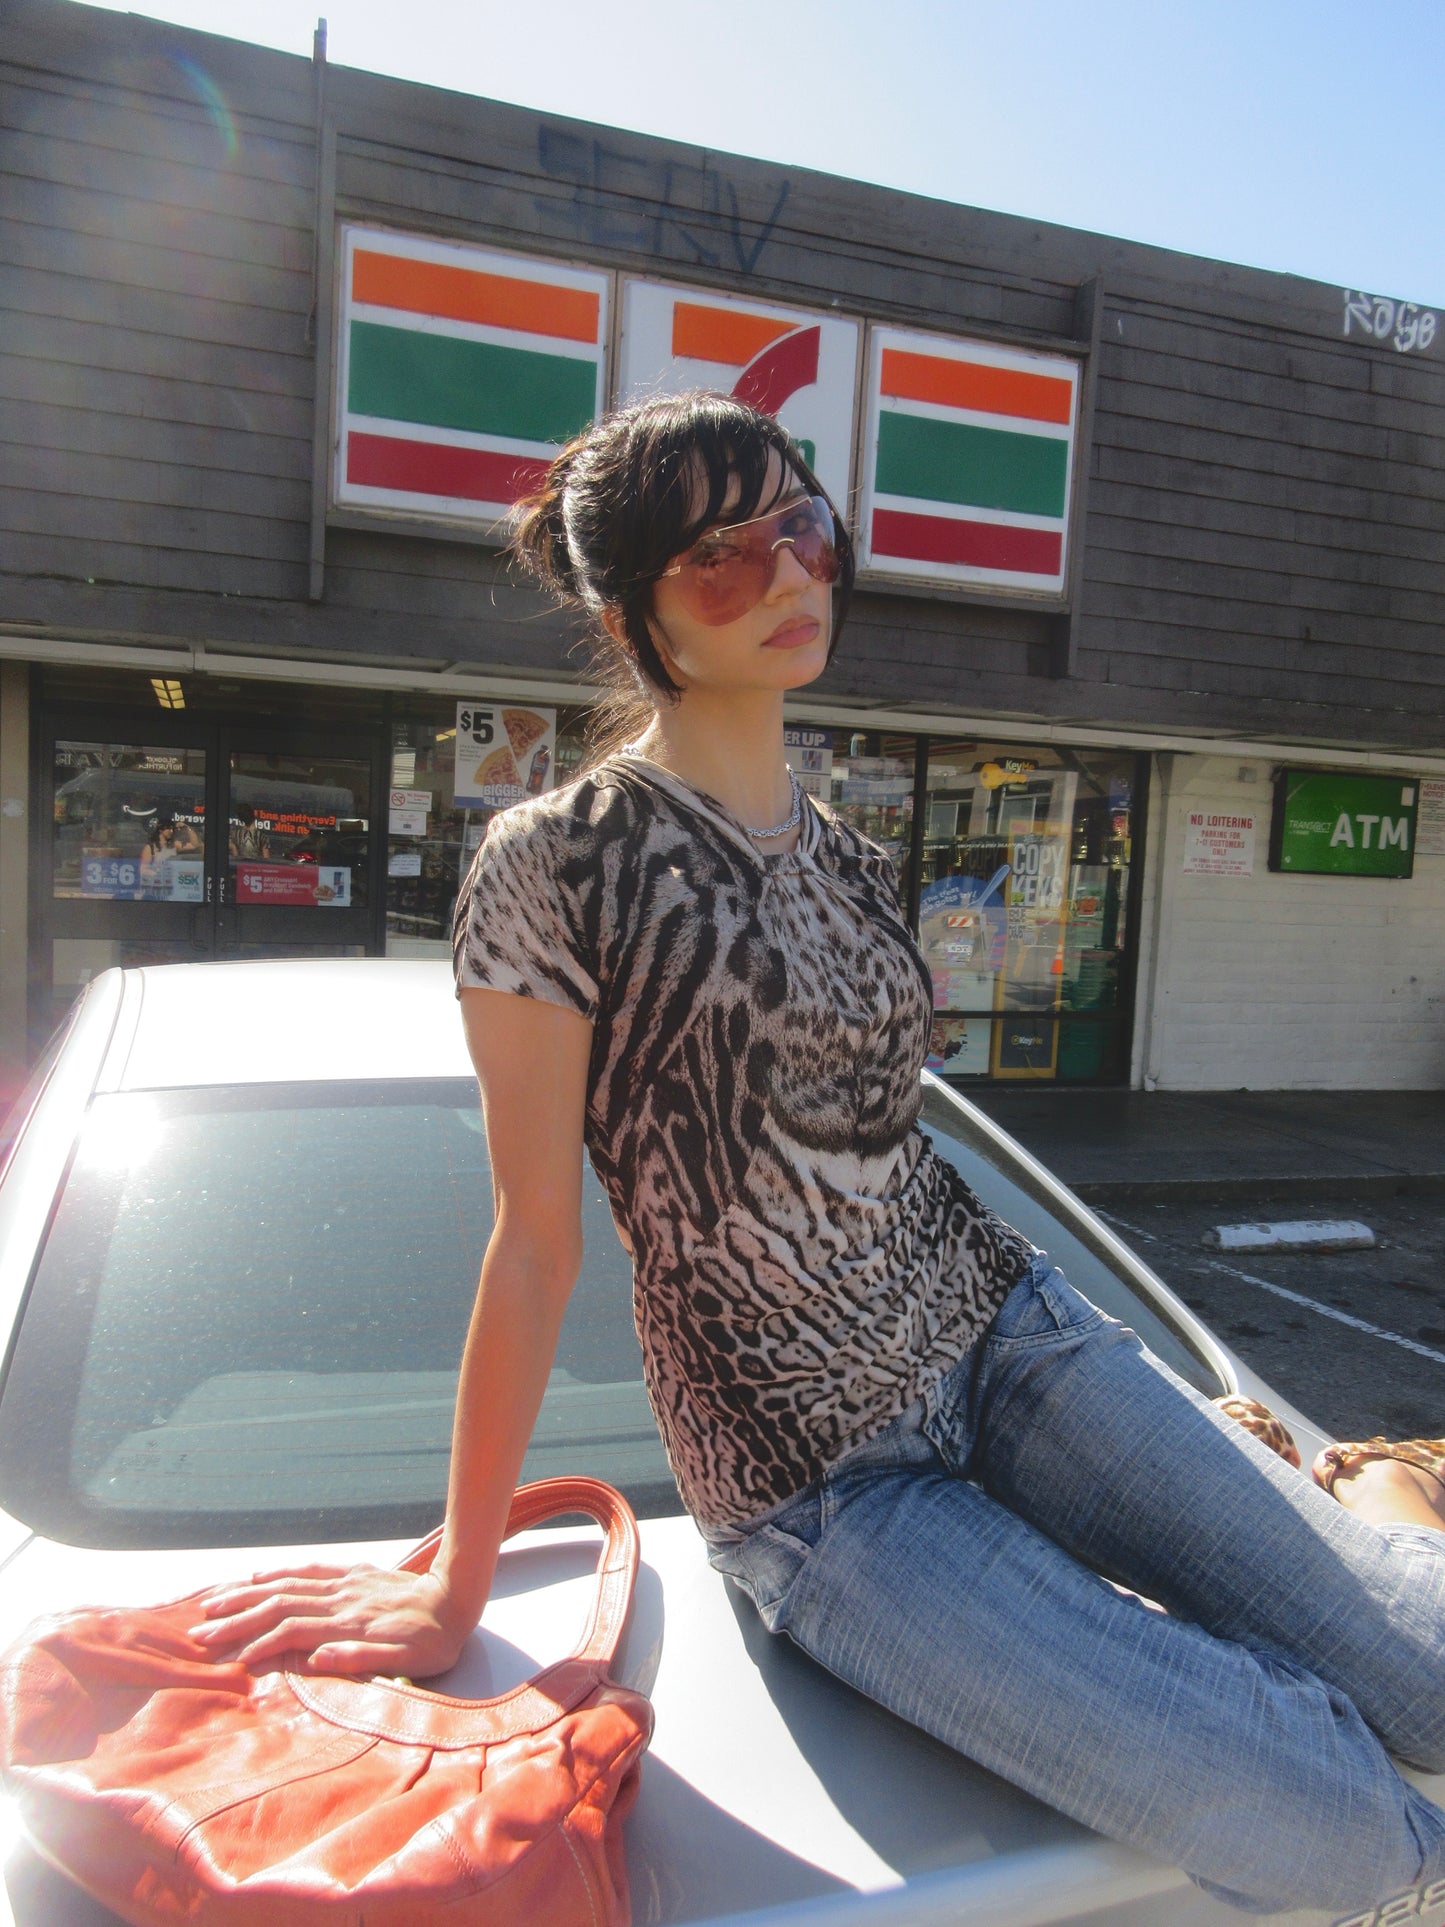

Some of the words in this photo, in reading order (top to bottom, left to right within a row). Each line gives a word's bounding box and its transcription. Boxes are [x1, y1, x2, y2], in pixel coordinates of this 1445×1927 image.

[460, 711, 494, 744] $5
[802, 732, 826, 746] UP
[1005, 760, 1035, 773] KeyMe
[483, 784, 525, 798] BIGGER
[1420, 783, 1445, 791] 7-ELEVE
[1190, 814, 1203, 825] NO
[1207, 815, 1253, 829] LOITERING
[1201, 830, 1227, 838] PARKING
[1228, 831, 1241, 839] FOR
[1329, 812, 1409, 851] ATM
[1209, 839, 1245, 848] CUSTOMERS
[1212, 847, 1227, 856] ONLY
[1013, 844, 1065, 875] COPY
[86, 863, 102, 884] 3
[103, 877, 117, 885] FOR
[111, 862, 135, 886] $6
[243, 874, 263, 893] $5
[1011, 874, 1063, 908] KEYS
